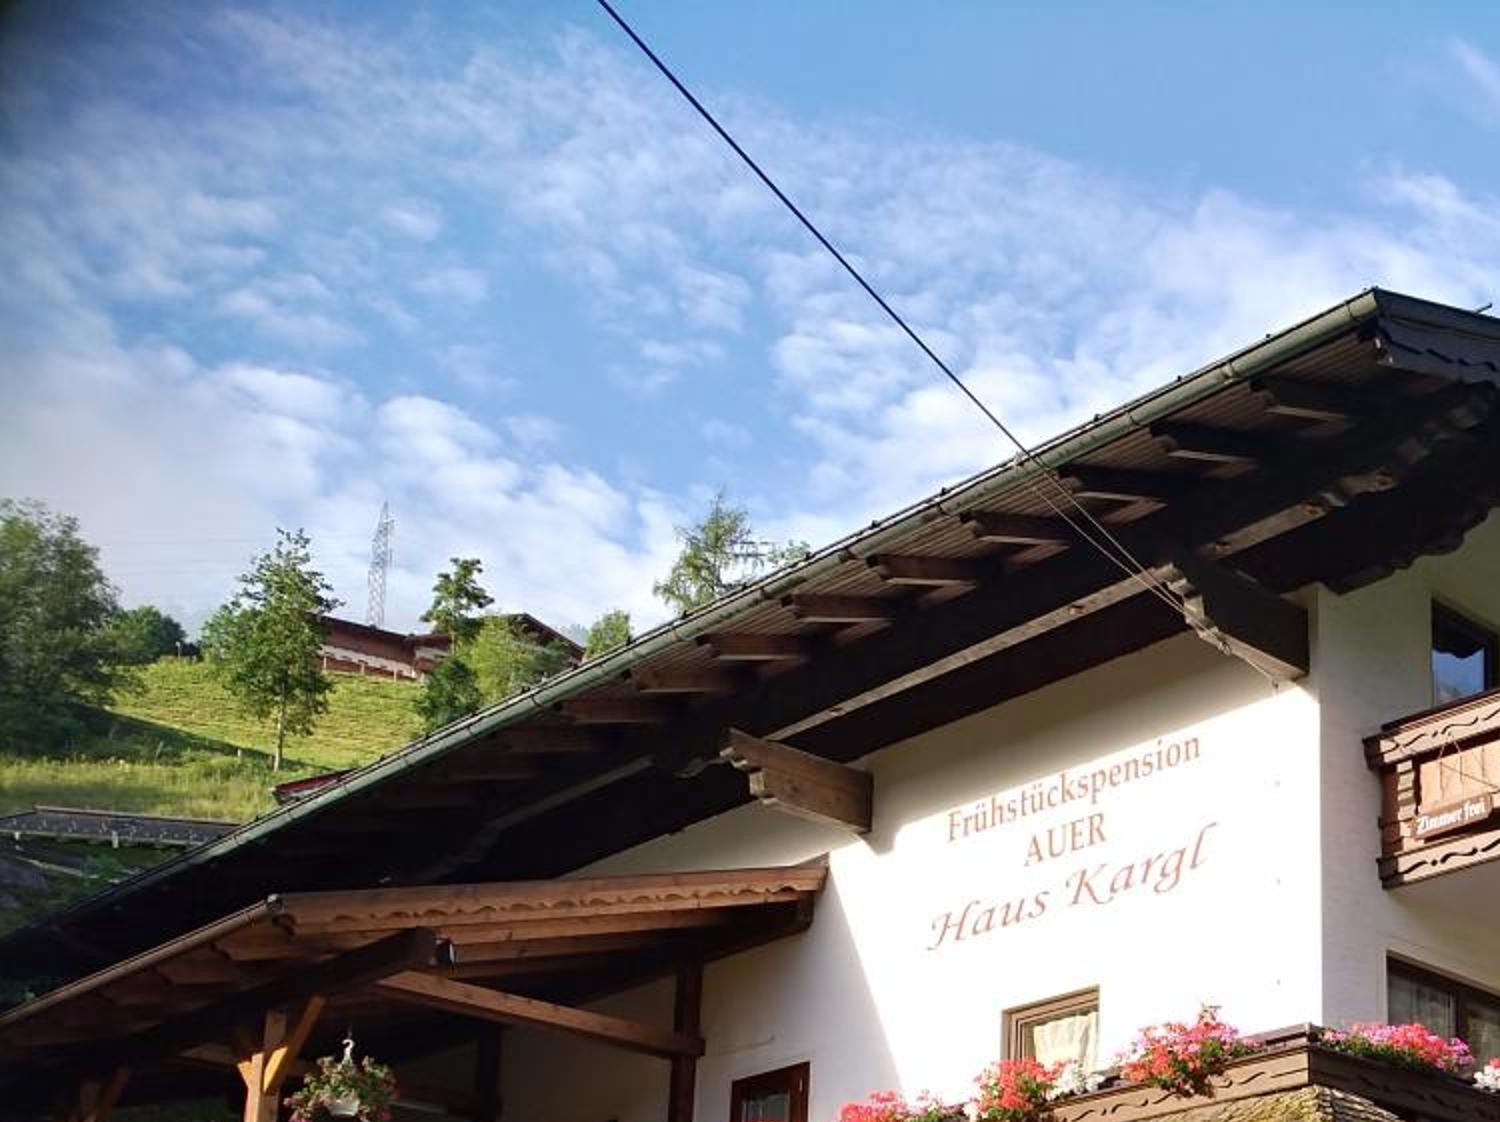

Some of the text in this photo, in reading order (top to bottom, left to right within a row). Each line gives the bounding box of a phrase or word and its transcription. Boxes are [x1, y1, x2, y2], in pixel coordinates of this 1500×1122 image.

[948, 736, 1201, 842] Frühstückspension
[1024, 812, 1107, 867] AUER
[926, 821, 1218, 951] Haus Kargl
